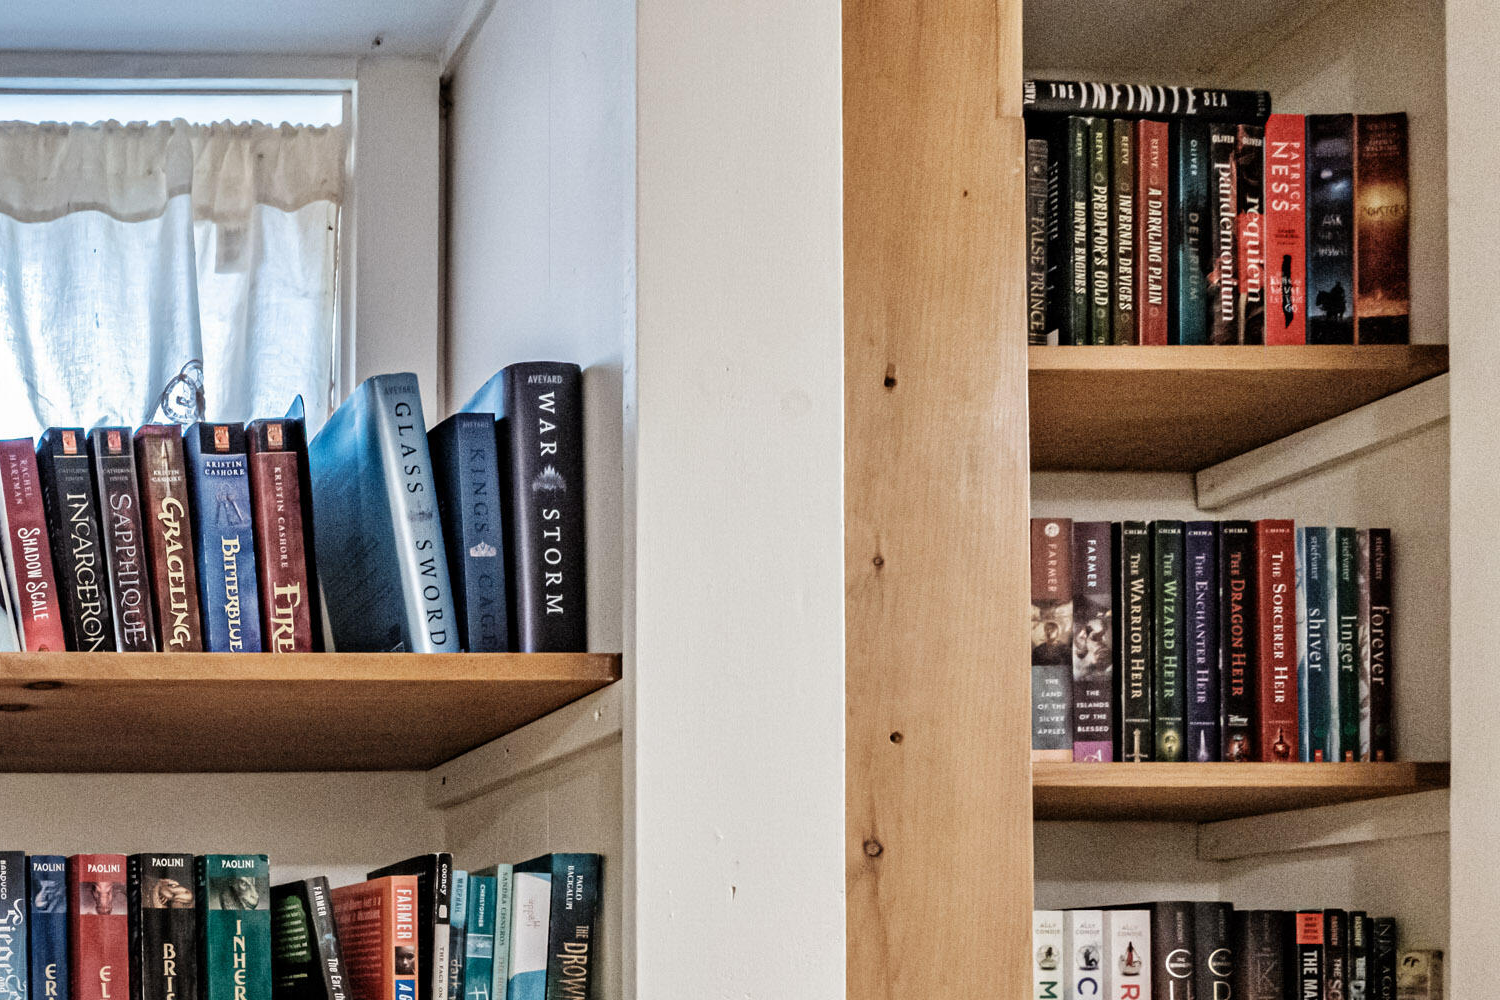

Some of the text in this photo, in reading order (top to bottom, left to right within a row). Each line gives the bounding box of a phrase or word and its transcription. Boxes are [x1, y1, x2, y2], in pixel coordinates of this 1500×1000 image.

[1051, 83, 1074, 99] THE
[1204, 92, 1228, 107] SEA
[1271, 141, 1289, 211] NESS
[1290, 142, 1301, 211] PATRICK
[1074, 200, 1087, 294] MORTAL ENGINES
[1118, 193, 1132, 311] INFERNAL DEVICES
[1148, 188, 1162, 305] A DARKLING PLAIN
[1214, 161, 1237, 321] pandemonium
[1245, 196, 1262, 304] requiem
[528, 375, 563, 385] AVEYARD
[395, 402, 447, 646] GLASS SWORD
[538, 391, 564, 615] WAR STORM
[17, 527, 49, 621] SHADOW SCALE
[65, 493, 105, 652] INCARCERON
[109, 493, 147, 647] SAPPHIQUE
[160, 497, 192, 648] GRACELING
[221, 535, 243, 652] BITTERBLUE
[272, 581, 300, 652] FIRE
[1129, 554, 1144, 700] THE WARRIOR HEIR
[1164, 553, 1177, 698] THE WIZARD HEIR
[1307, 608, 1326, 672] shiver
[1370, 605, 1390, 686] forever
[33, 863, 65, 872] PAOLINI
[396, 888, 412, 939] FARMER
[575, 925, 589, 941] THE
[1303, 951, 1318, 973] THE
[399, 983, 411, 991] A
